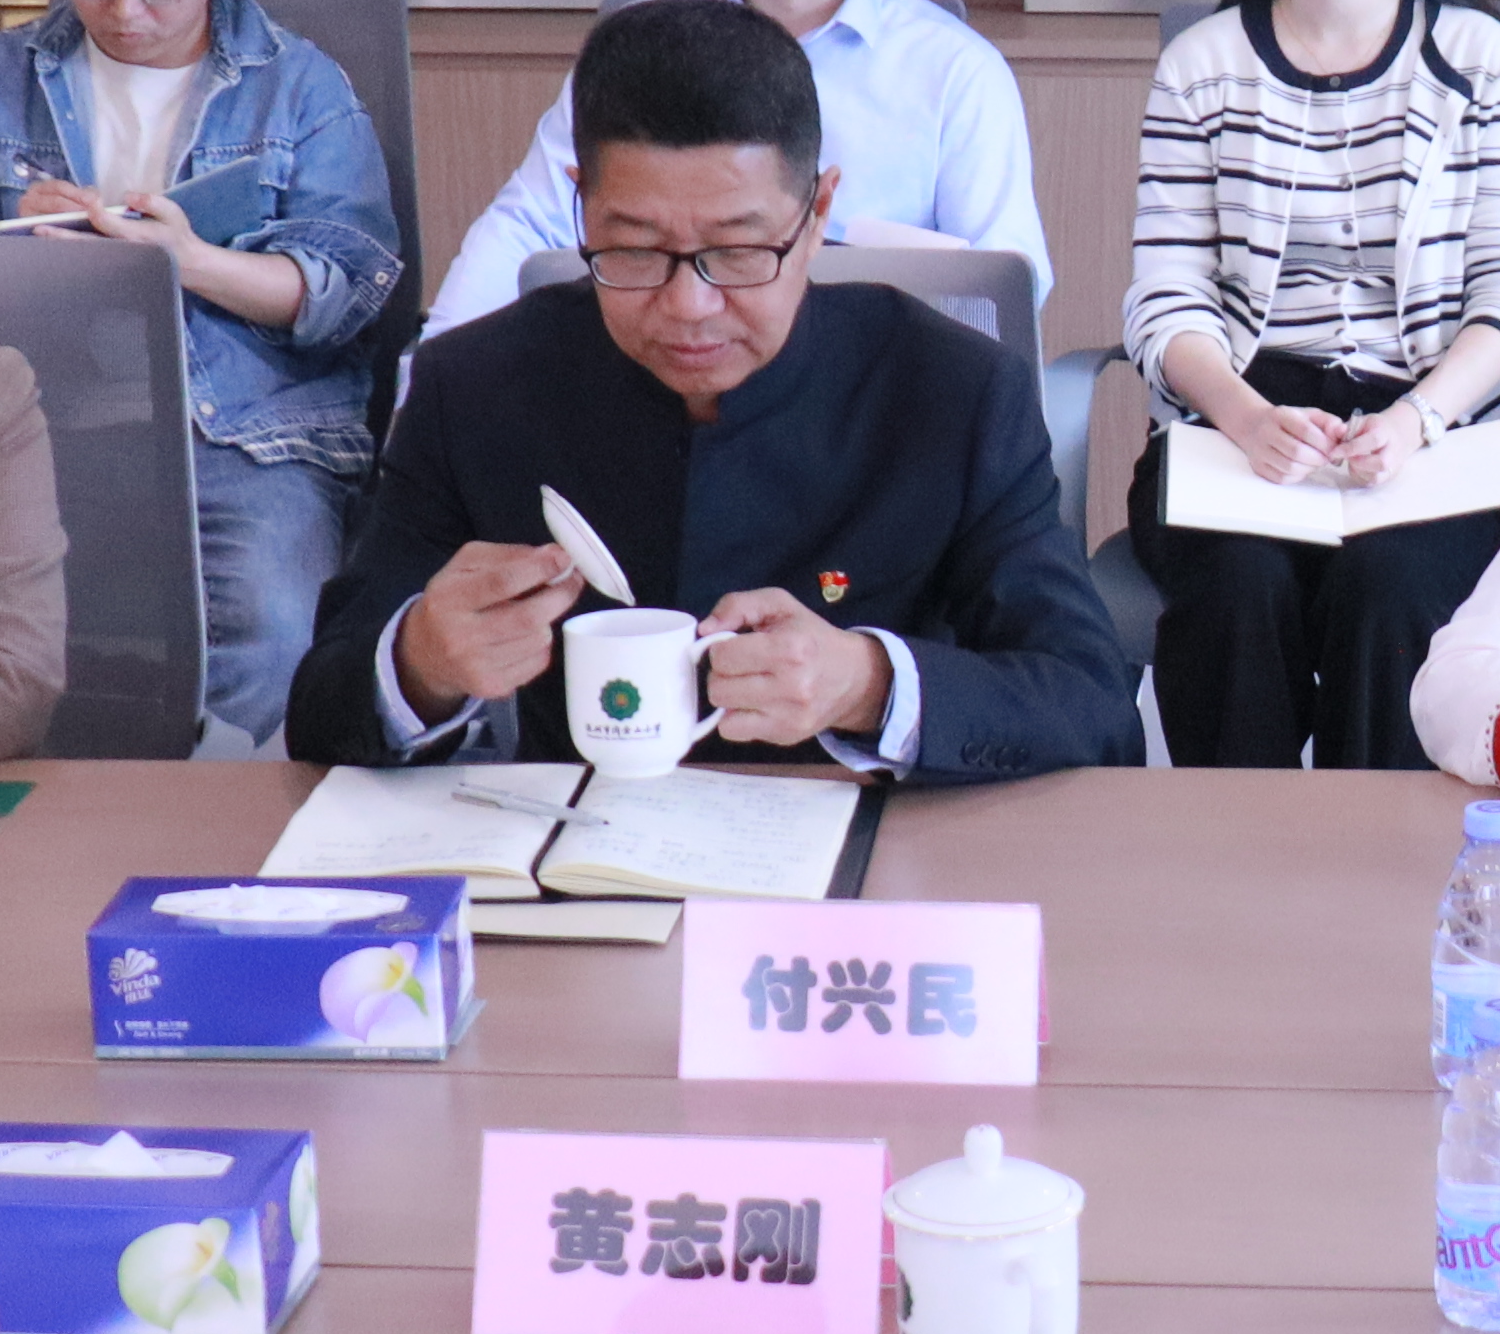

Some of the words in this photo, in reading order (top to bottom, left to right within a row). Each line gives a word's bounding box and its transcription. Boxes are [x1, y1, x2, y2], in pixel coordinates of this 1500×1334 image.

[741, 954, 977, 1039] 付兴民
[549, 1186, 822, 1287] 黄志刚
